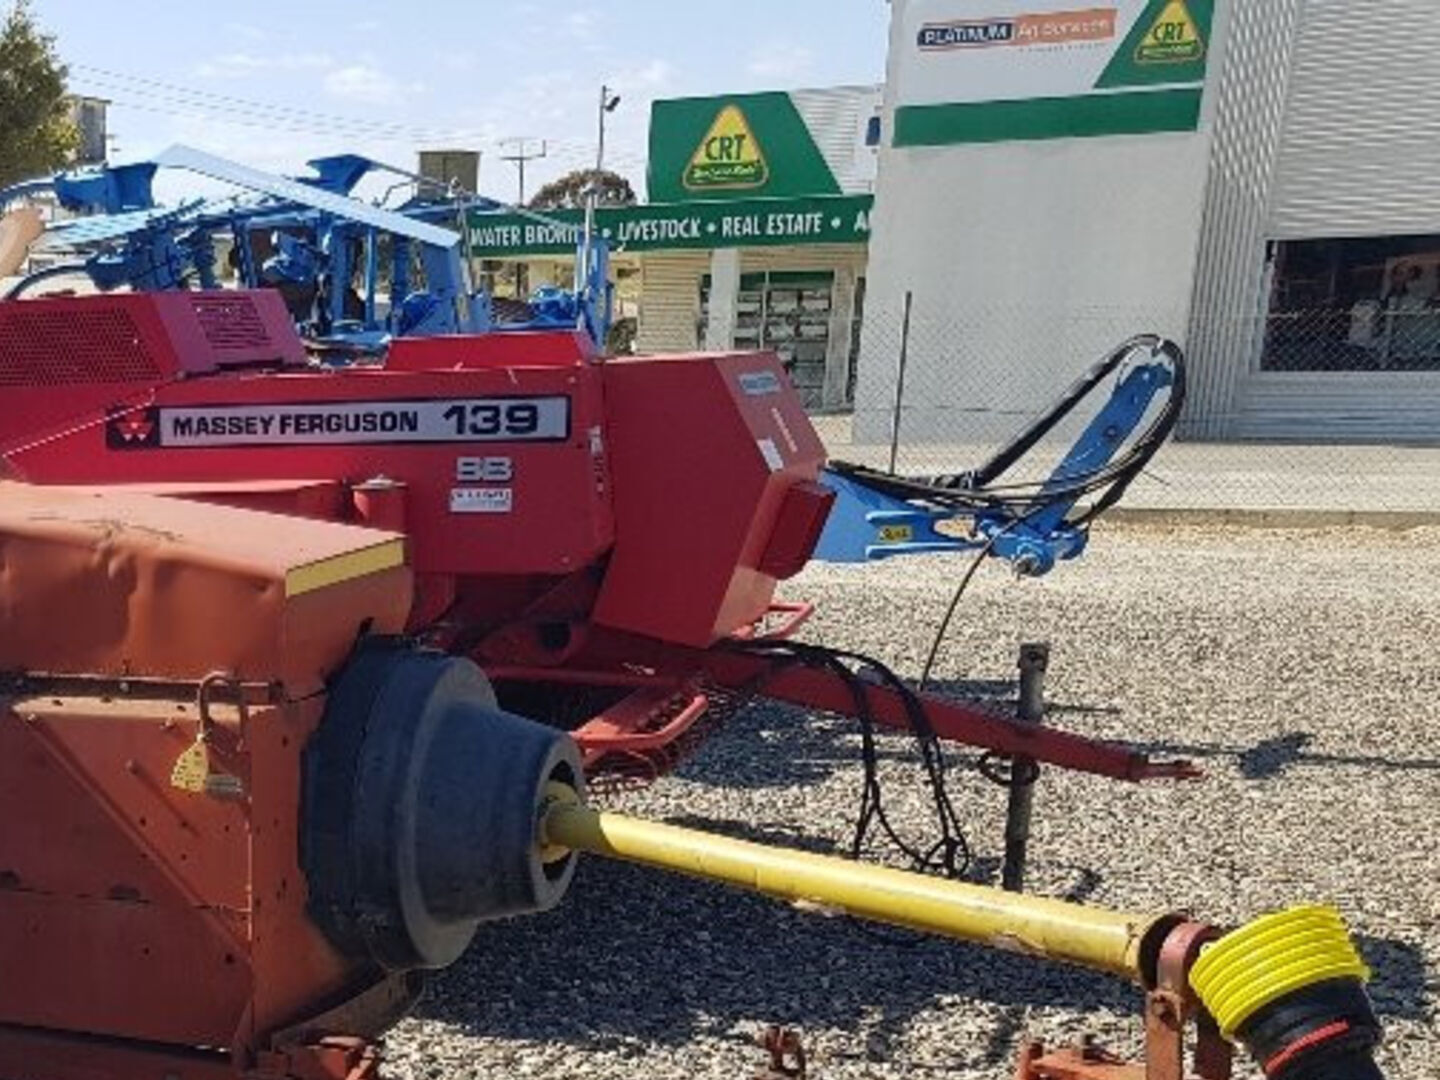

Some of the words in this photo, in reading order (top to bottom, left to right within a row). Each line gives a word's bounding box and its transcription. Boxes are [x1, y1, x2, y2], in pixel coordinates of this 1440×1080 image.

[924, 22, 1007, 44] PLATINUM
[1153, 22, 1186, 41] CRT
[704, 133, 747, 161] CRT
[469, 225, 521, 247] WATER
[616, 216, 702, 242] LIVESTOCK
[721, 215, 761, 238] REAL
[765, 211, 824, 236] ESTATE
[172, 414, 275, 438] MASSEY
[278, 410, 420, 436] FERGUSON
[442, 404, 540, 436] 139
